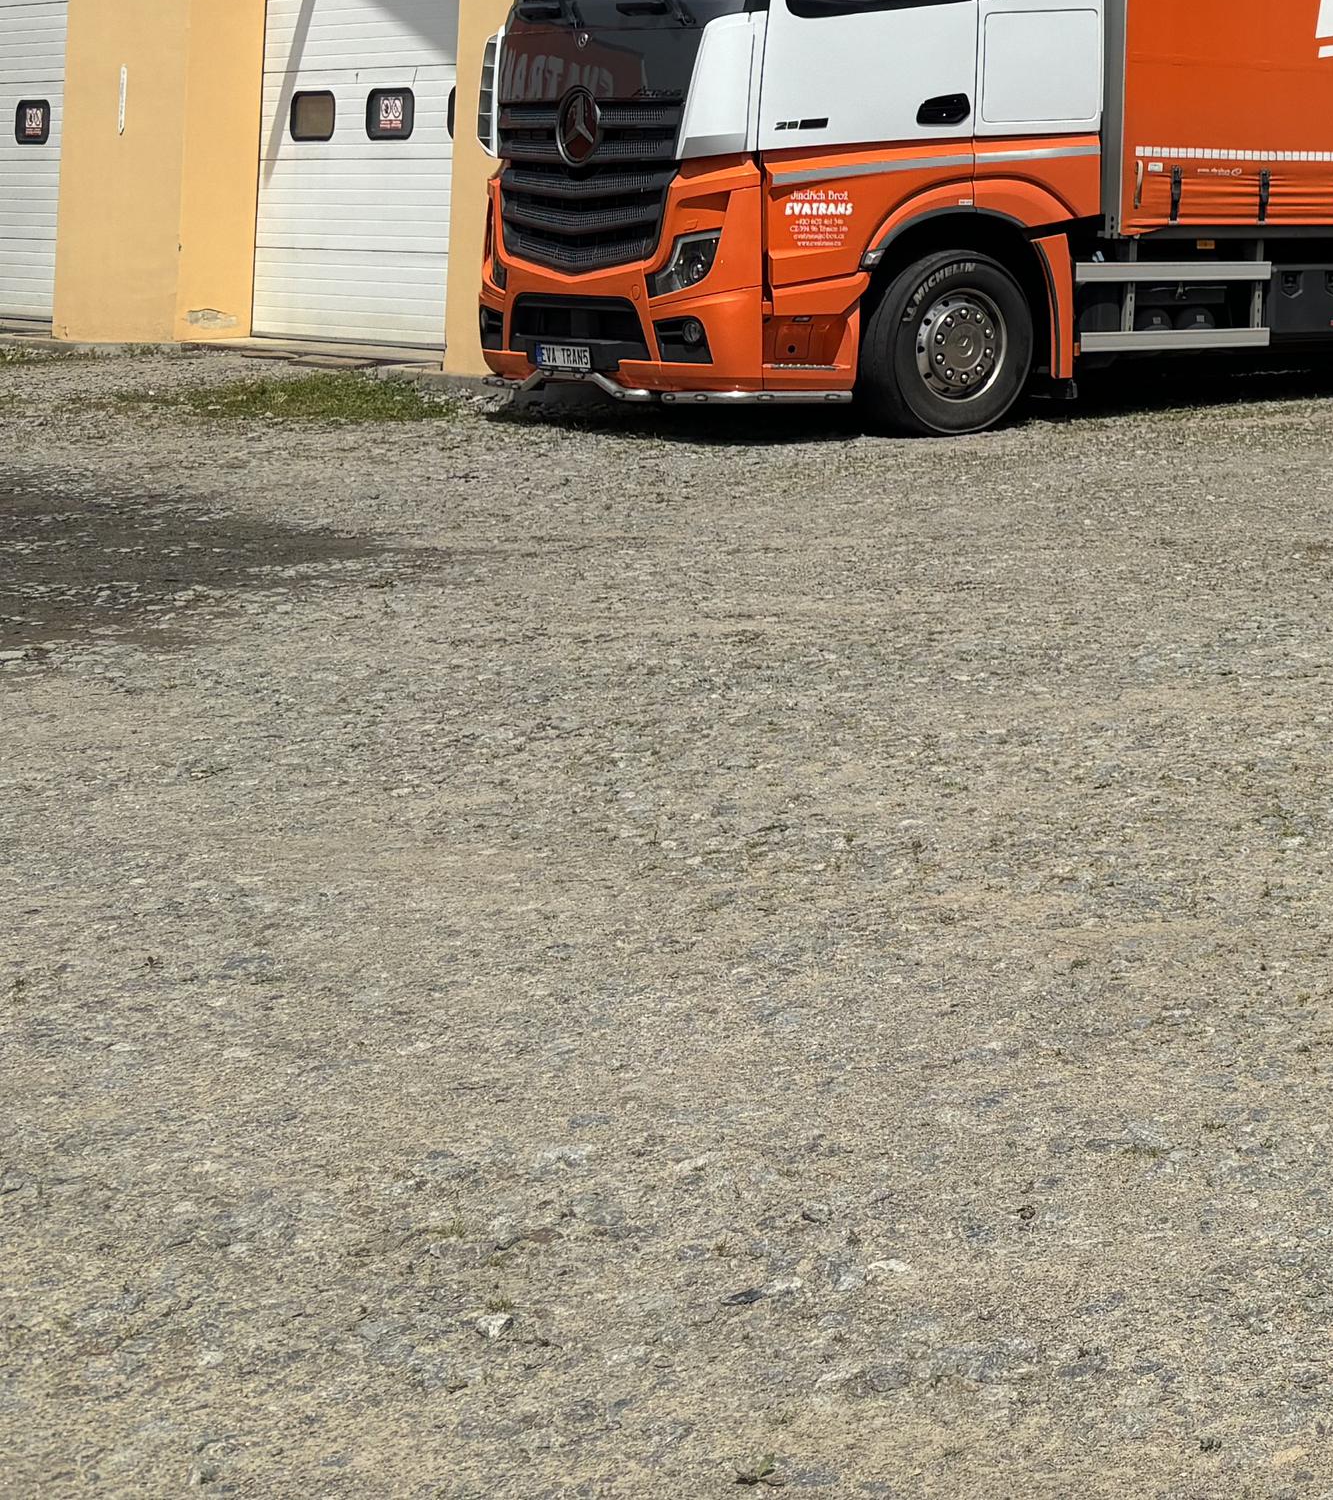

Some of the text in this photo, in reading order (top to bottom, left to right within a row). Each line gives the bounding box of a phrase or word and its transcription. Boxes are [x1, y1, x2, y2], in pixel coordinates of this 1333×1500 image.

[785, 202, 853, 216] EVATRANS
[913, 262, 976, 305] MICHELIN
[541, 346, 557, 363] EVA
